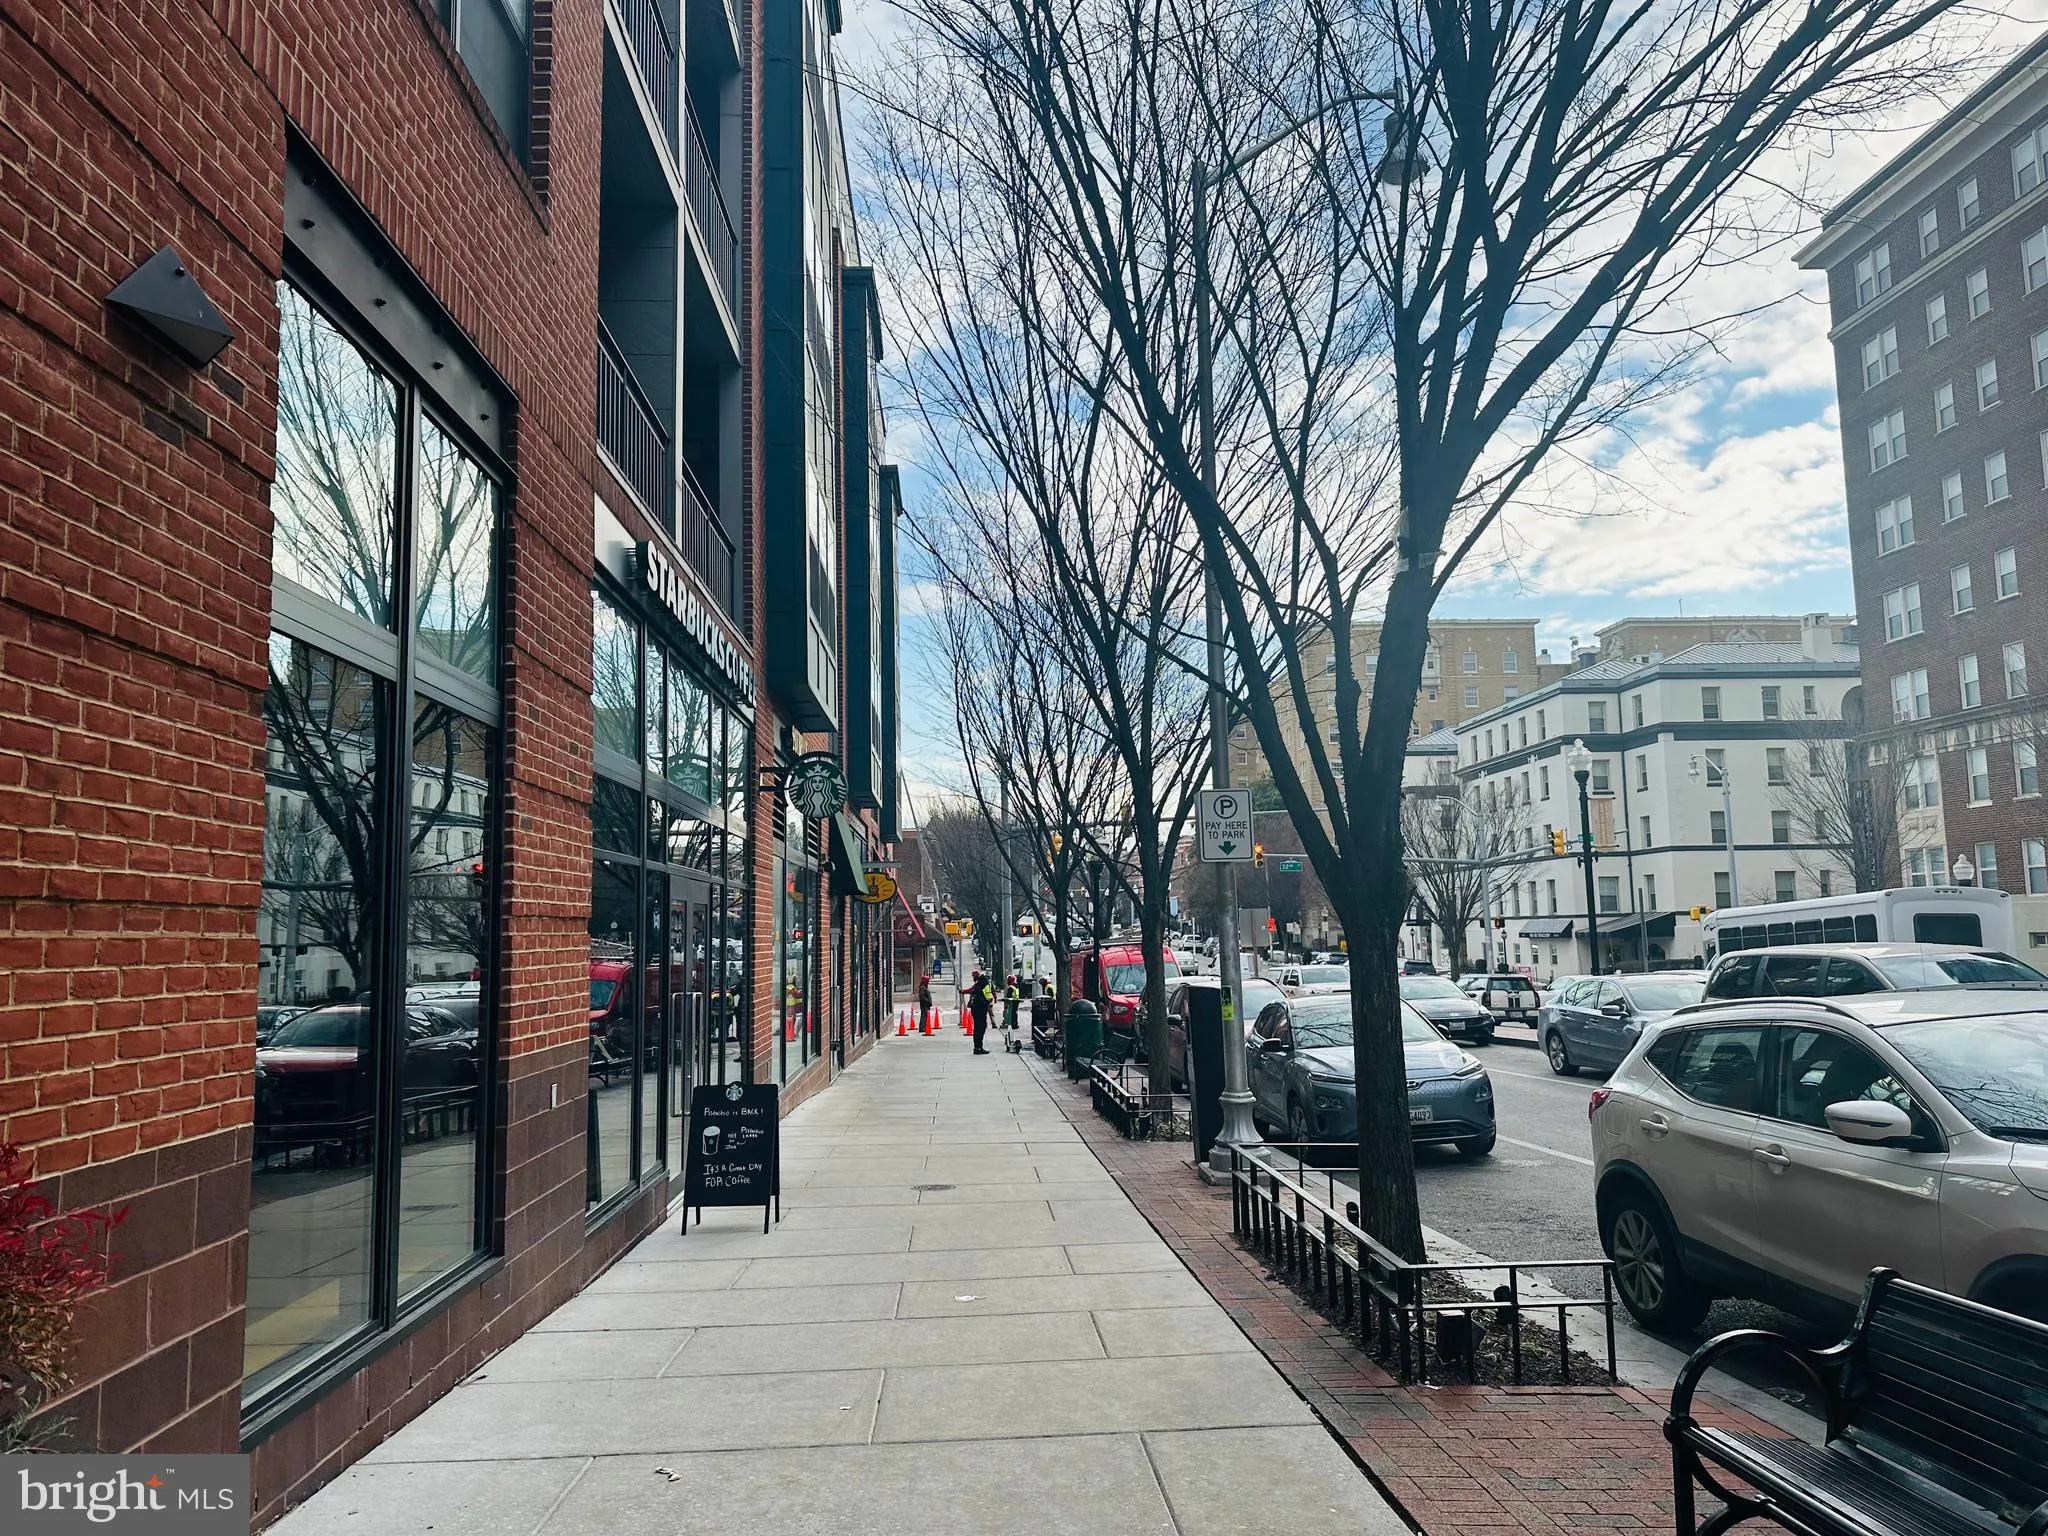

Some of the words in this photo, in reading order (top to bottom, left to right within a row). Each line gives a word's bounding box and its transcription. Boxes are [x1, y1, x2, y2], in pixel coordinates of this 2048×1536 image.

[647, 540, 725, 670] STARBUCKS
[1220, 799, 1233, 815] P
[1205, 821, 1221, 830] PAY
[1225, 821, 1248, 830] HERE
[1208, 831, 1219, 839] TO
[1222, 831, 1246, 839] PARK
